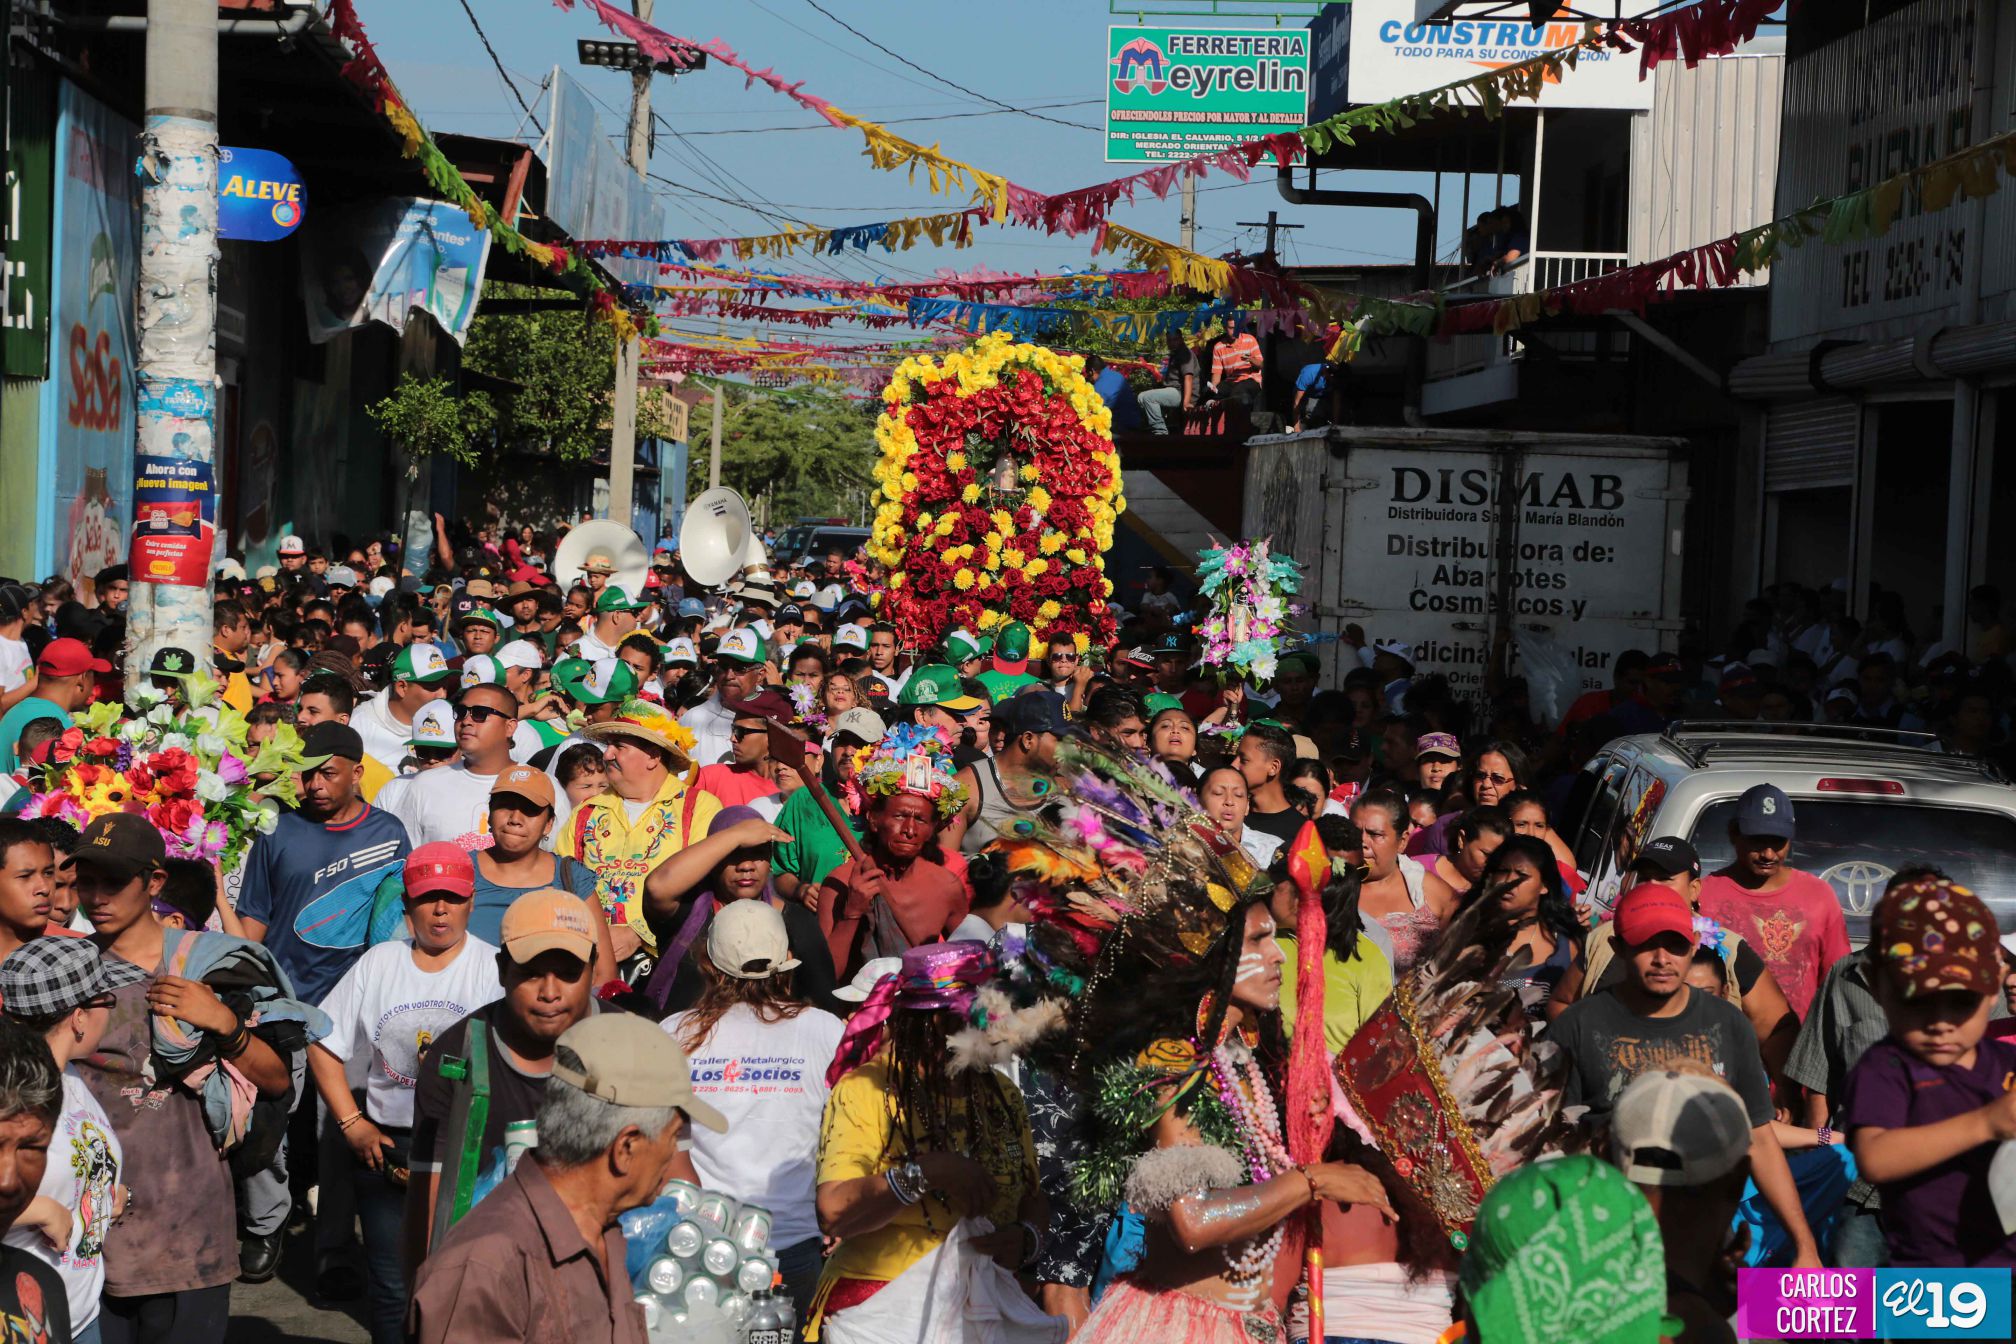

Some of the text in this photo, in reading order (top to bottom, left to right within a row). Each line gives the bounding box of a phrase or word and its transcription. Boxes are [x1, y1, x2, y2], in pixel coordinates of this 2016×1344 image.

[1168, 35, 1305, 56] FERRETERIA
[1394, 46, 1611, 62] TODO PARA SU CONSCION
[1111, 109, 1304, 125] OFRECIENDOLES PRECIOS POR MAYOR Y AL DETALLE
[1110, 132, 1129, 140] DIR:
[1131, 132, 1169, 141] IGLESIA
[1171, 133, 1183, 141] EL
[1185, 134, 1235, 143] CALVARIO,
[1135, 141, 1229, 151] MERCADO ORIENTAL
[222, 174, 302, 202] ALEVE
[145, 463, 198, 477] Ahora con
[1387, 506, 1477, 523] Distribuidora
[1525, 511, 1564, 526] María
[1567, 511, 1626, 528] Blandón
[1572, 541, 1615, 563] de:
[1571, 598, 1588, 622] y
[1762, 796, 1777, 815] S
[92, 836, 112, 847] ASU
[393, 1003, 410, 1014] CON
[692, 1056, 806, 1066] Taller Metalurgico
[690, 1066, 802, 1082] Los Socios
